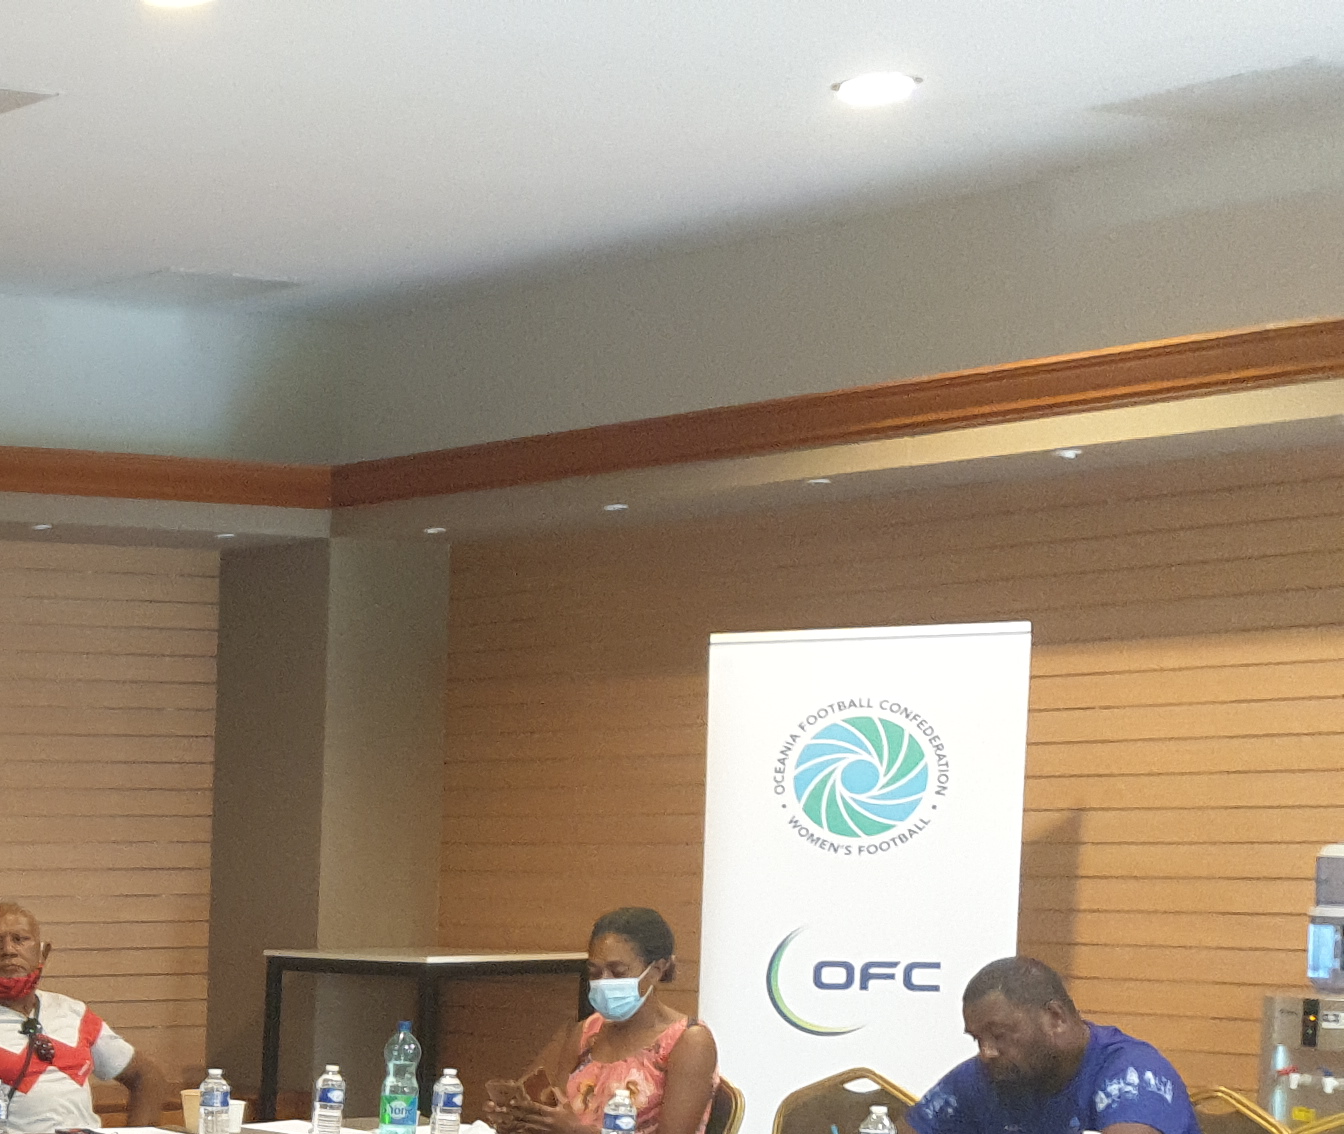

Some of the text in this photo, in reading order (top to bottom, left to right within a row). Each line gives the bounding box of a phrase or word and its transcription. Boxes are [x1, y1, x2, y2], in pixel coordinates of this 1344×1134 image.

[773, 697, 950, 797] OCEANIA FOOTBALL CONFEDERATION
[787, 815, 932, 856] WOMEN'S FOOTBALL
[812, 960, 942, 993] OFC
